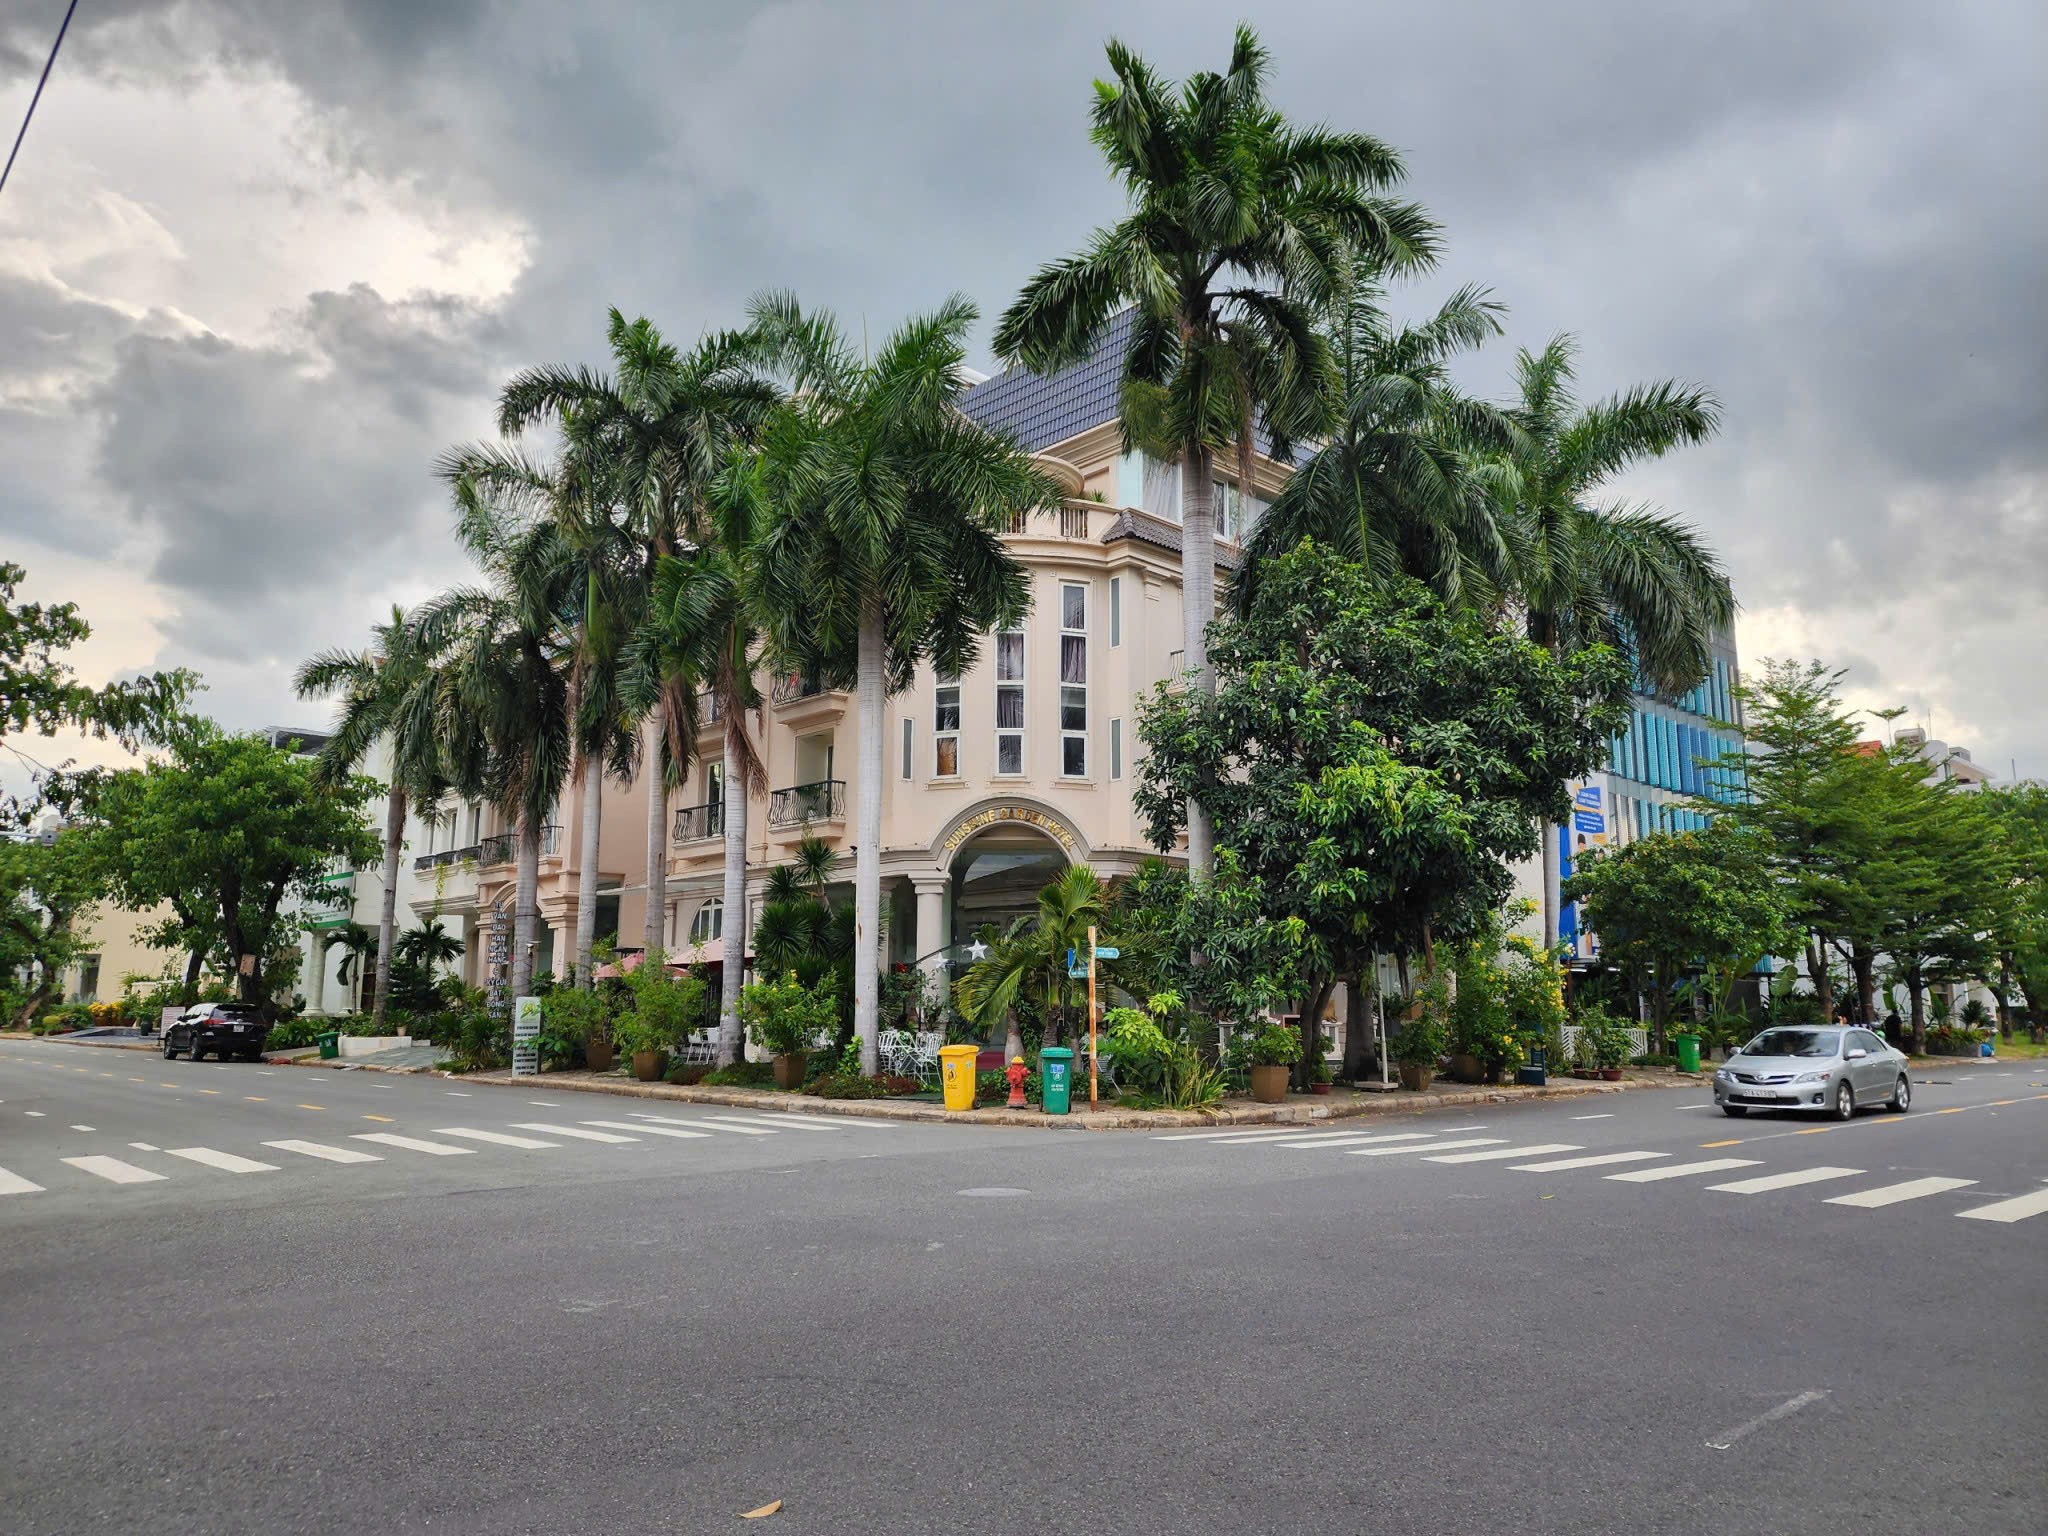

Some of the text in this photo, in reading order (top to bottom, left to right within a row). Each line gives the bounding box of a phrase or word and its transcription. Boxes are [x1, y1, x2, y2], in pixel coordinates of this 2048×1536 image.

[944, 807, 1076, 853] SUNSHINE GARDEN HOTEL
